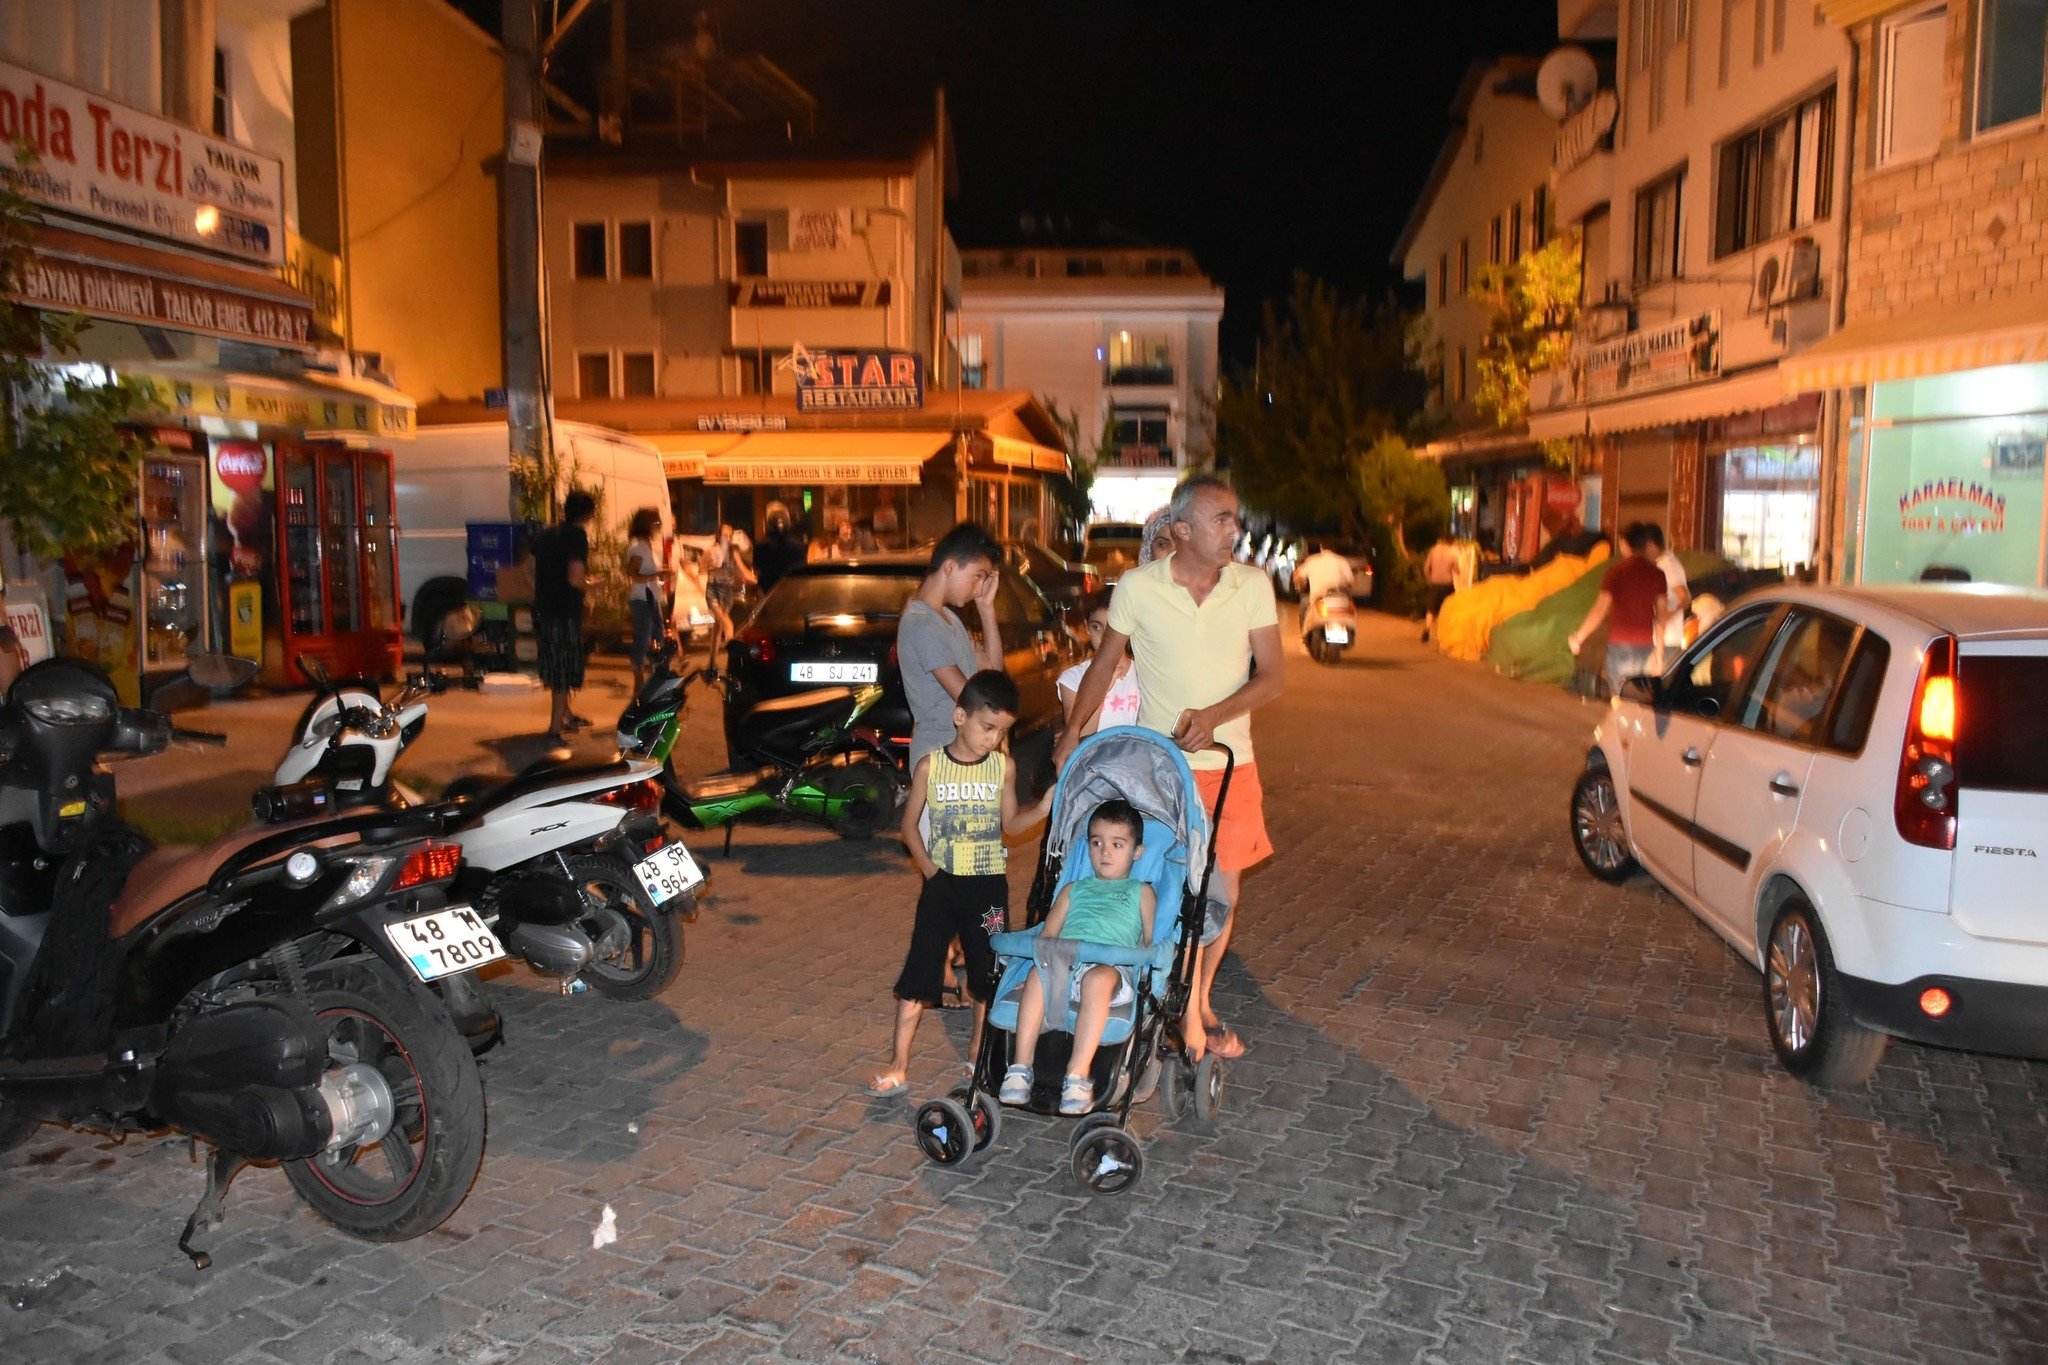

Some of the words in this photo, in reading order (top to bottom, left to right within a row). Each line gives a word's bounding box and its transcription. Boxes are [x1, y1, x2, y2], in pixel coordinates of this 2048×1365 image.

[87, 102, 184, 197] Terzi
[205, 144, 260, 184] TAILOR
[25, 264, 81, 306] BAYAN
[162, 288, 215, 328] TAILOR
[216, 299, 251, 334] EMEL
[253, 307, 276, 338] 412
[1648, 327, 1686, 353] MARKET
[815, 354, 916, 388] STAR
[802, 388, 918, 408] RESTAURANT
[778, 465, 820, 478] LAHMACUN
[835, 466, 860, 478] KEBAP
[8, 608, 42, 638] ERZİ
[799, 665, 814, 679] 48
[829, 665, 843, 680] SJ
[852, 665, 872, 680] 241
[945, 804, 968, 816] EST
[972, 804, 987, 816] 62
[641, 861, 661, 881] 48
[667, 847, 688, 867] SR
[1973, 845, 2038, 858] FIESTA
[661, 871, 689, 895] 964
[408, 918, 444, 944] 48
[458, 911, 481, 931] M
[430, 935, 495, 969] 7809
